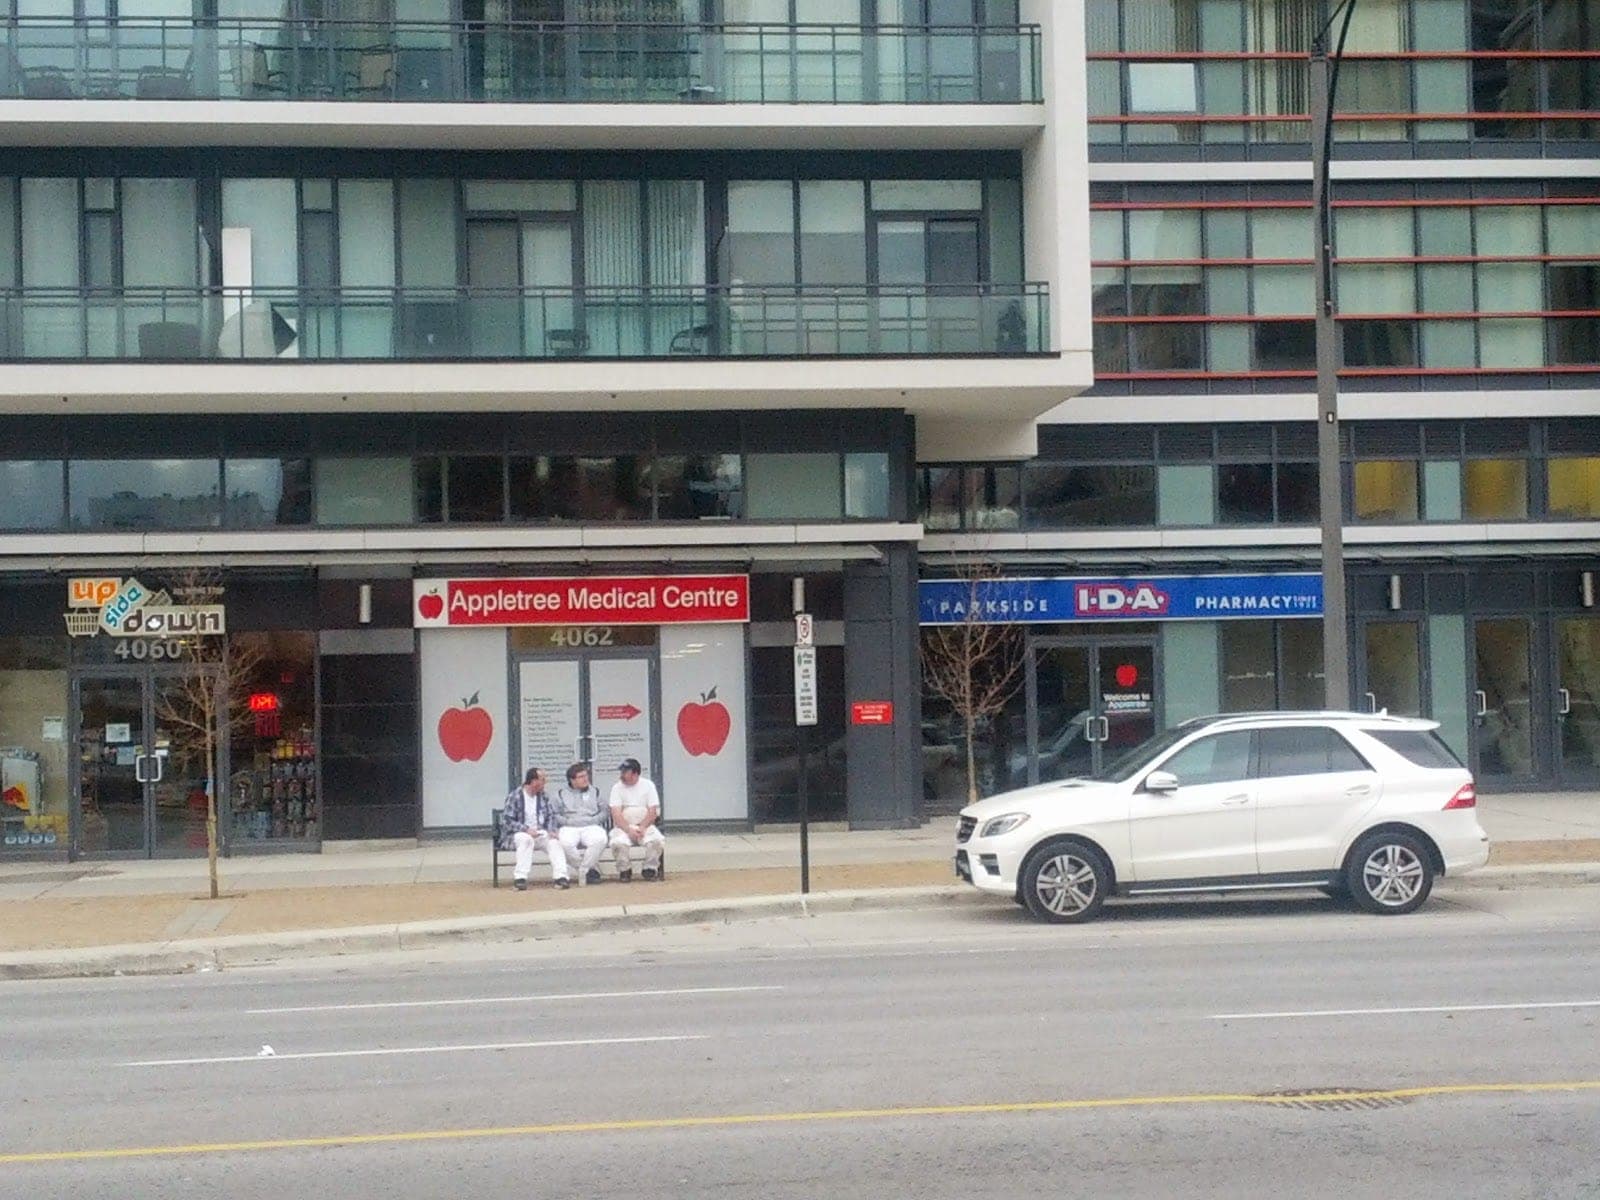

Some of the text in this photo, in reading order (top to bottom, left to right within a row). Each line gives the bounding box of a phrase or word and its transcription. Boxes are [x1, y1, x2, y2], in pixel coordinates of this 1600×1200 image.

[73, 580, 117, 605] up
[450, 585, 739, 616] Appletree Medical Centre
[1195, 596, 1291, 610] PHARMACY
[940, 599, 1048, 614] PARKSIDE
[123, 609, 220, 632] down
[550, 627, 613, 647] 4062
[114, 638, 183, 659] 4060
